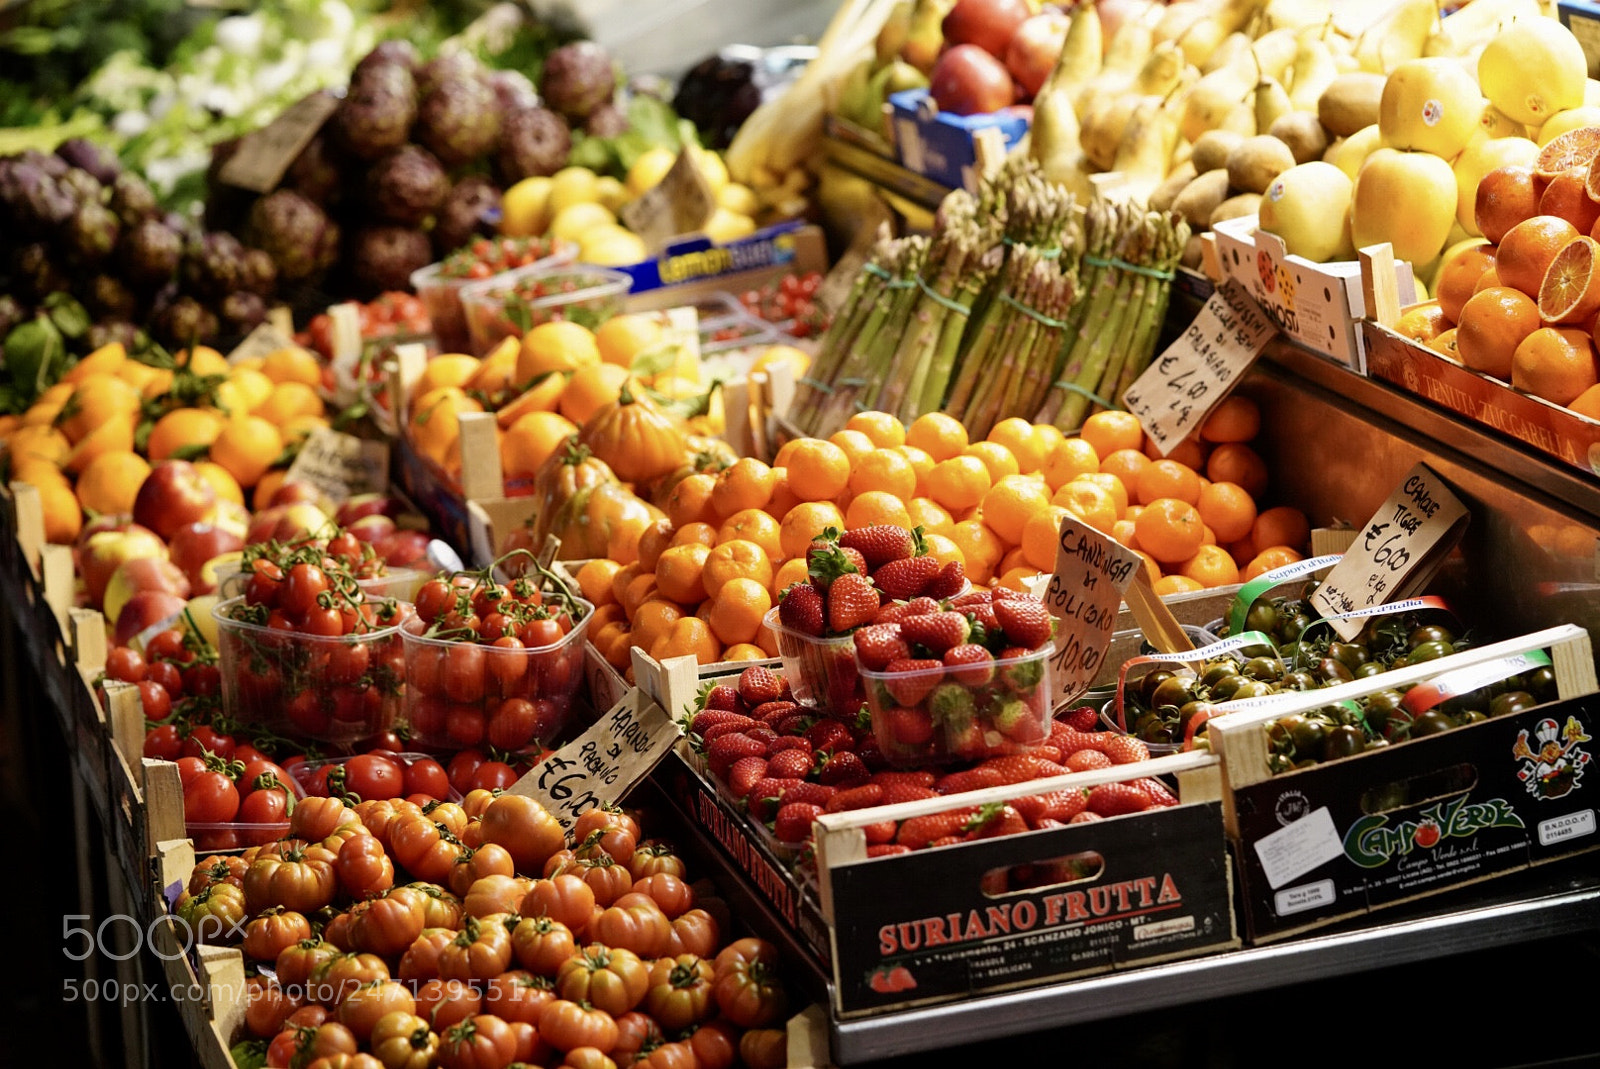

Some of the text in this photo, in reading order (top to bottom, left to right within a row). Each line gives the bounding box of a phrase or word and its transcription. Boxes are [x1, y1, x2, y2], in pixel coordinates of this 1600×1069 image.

[1422, 374, 1478, 417] TENUTA
[1268, 565, 1307, 582] Sapori
[1047, 575, 1114, 632] POLICORO
[879, 872, 1183, 957] SURIANO FRUTTA
[1023, 927, 1082, 946] SCANZANO
[1083, 919, 1124, 936] JONICO
